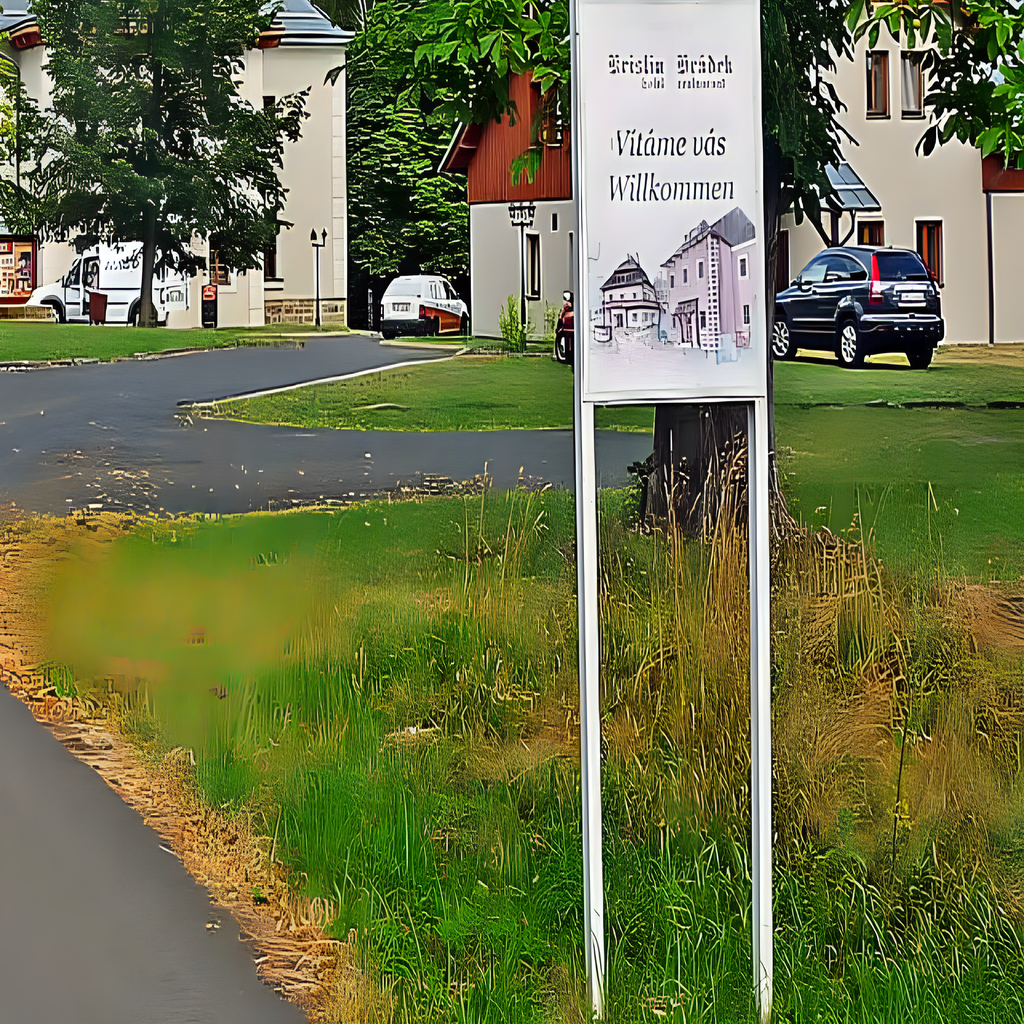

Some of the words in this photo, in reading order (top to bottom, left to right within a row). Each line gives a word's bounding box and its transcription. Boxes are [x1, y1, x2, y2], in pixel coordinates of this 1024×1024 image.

[616, 128, 687, 157] Vítáme
[693, 127, 727, 156] vás
[609, 172, 734, 202] Willkommen
